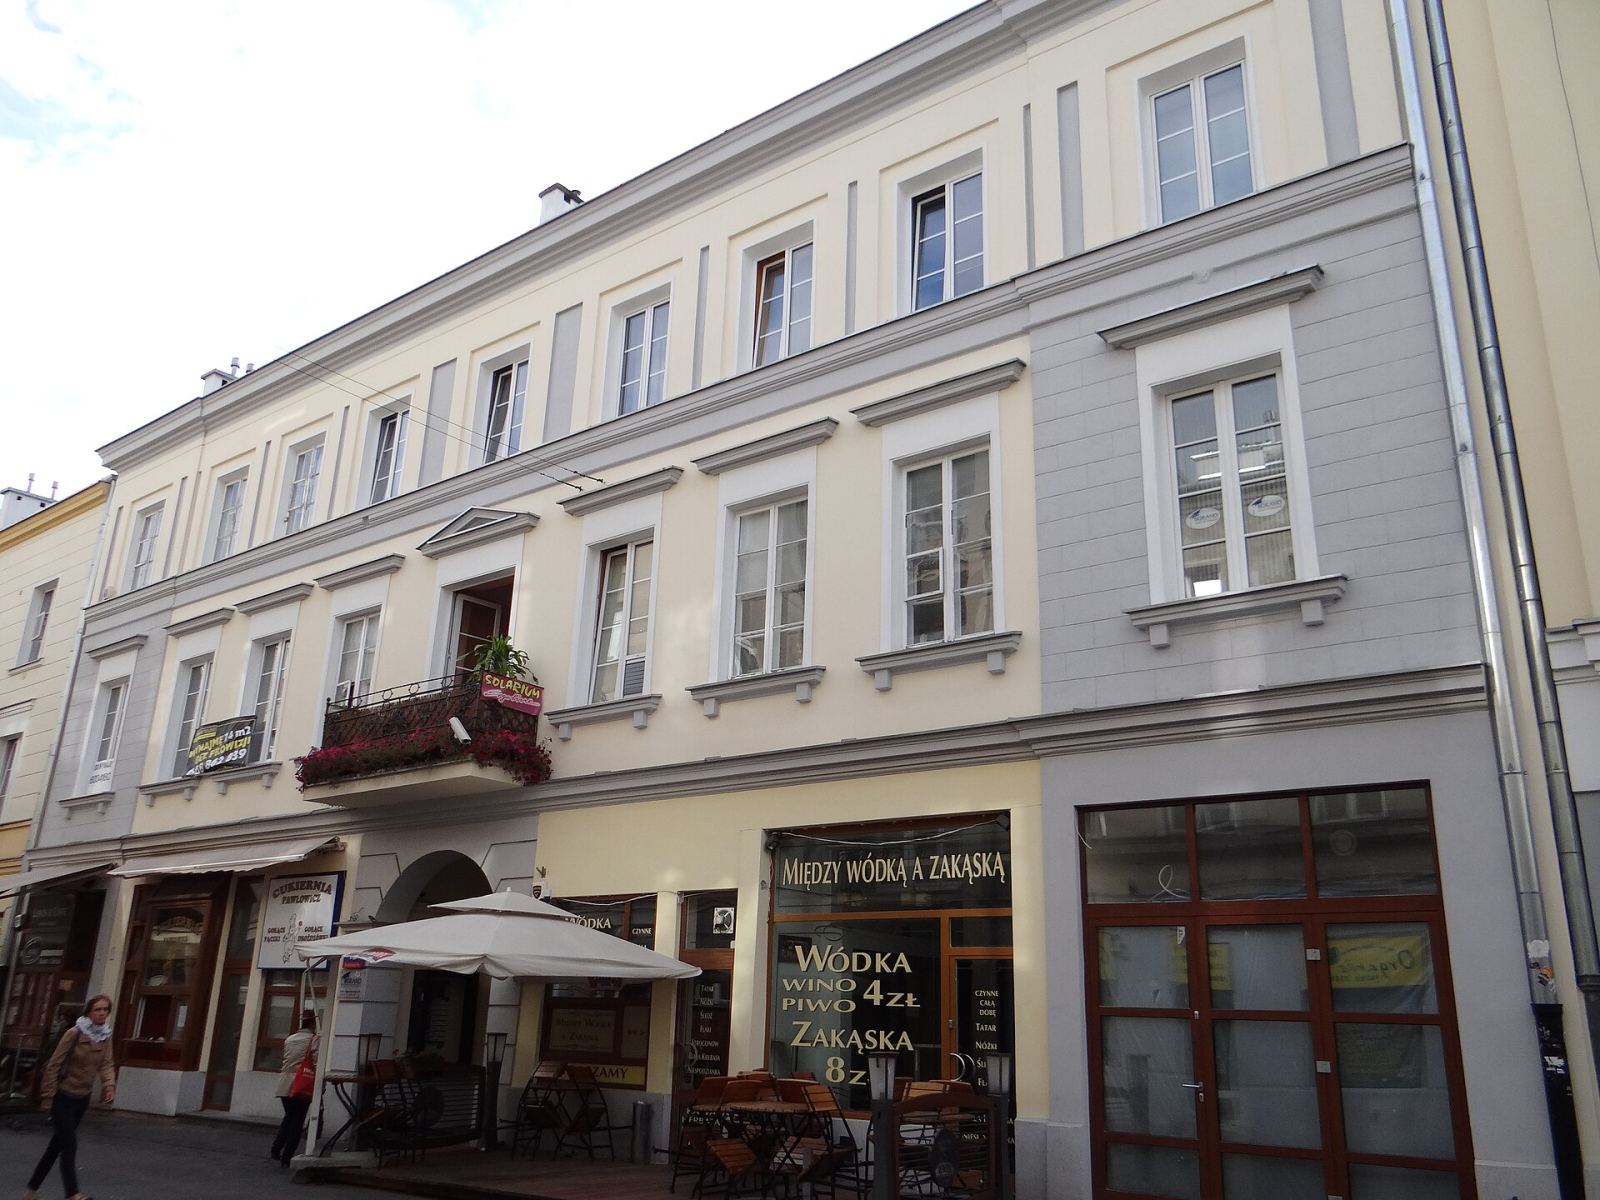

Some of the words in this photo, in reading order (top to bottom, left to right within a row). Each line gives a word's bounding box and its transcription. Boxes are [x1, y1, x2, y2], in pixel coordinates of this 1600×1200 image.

[485, 674, 540, 698] SOLARIUM
[782, 857, 842, 891] MIĘDZY
[846, 852, 908, 888] WÓDKĄ
[912, 856, 924, 881] A
[929, 851, 1006, 884] ZAKĄSKĄ
[272, 880, 332, 899] CUKIERNIA
[794, 944, 912, 973] WÓDKA
[782, 978, 857, 992] WINO
[782, 997, 857, 1013] PIWO
[975, 1023, 997, 1032] TATAR
[790, 1021, 914, 1055] ZAKĄSKA
[975, 1040, 998, 1050] NÓŻKI
